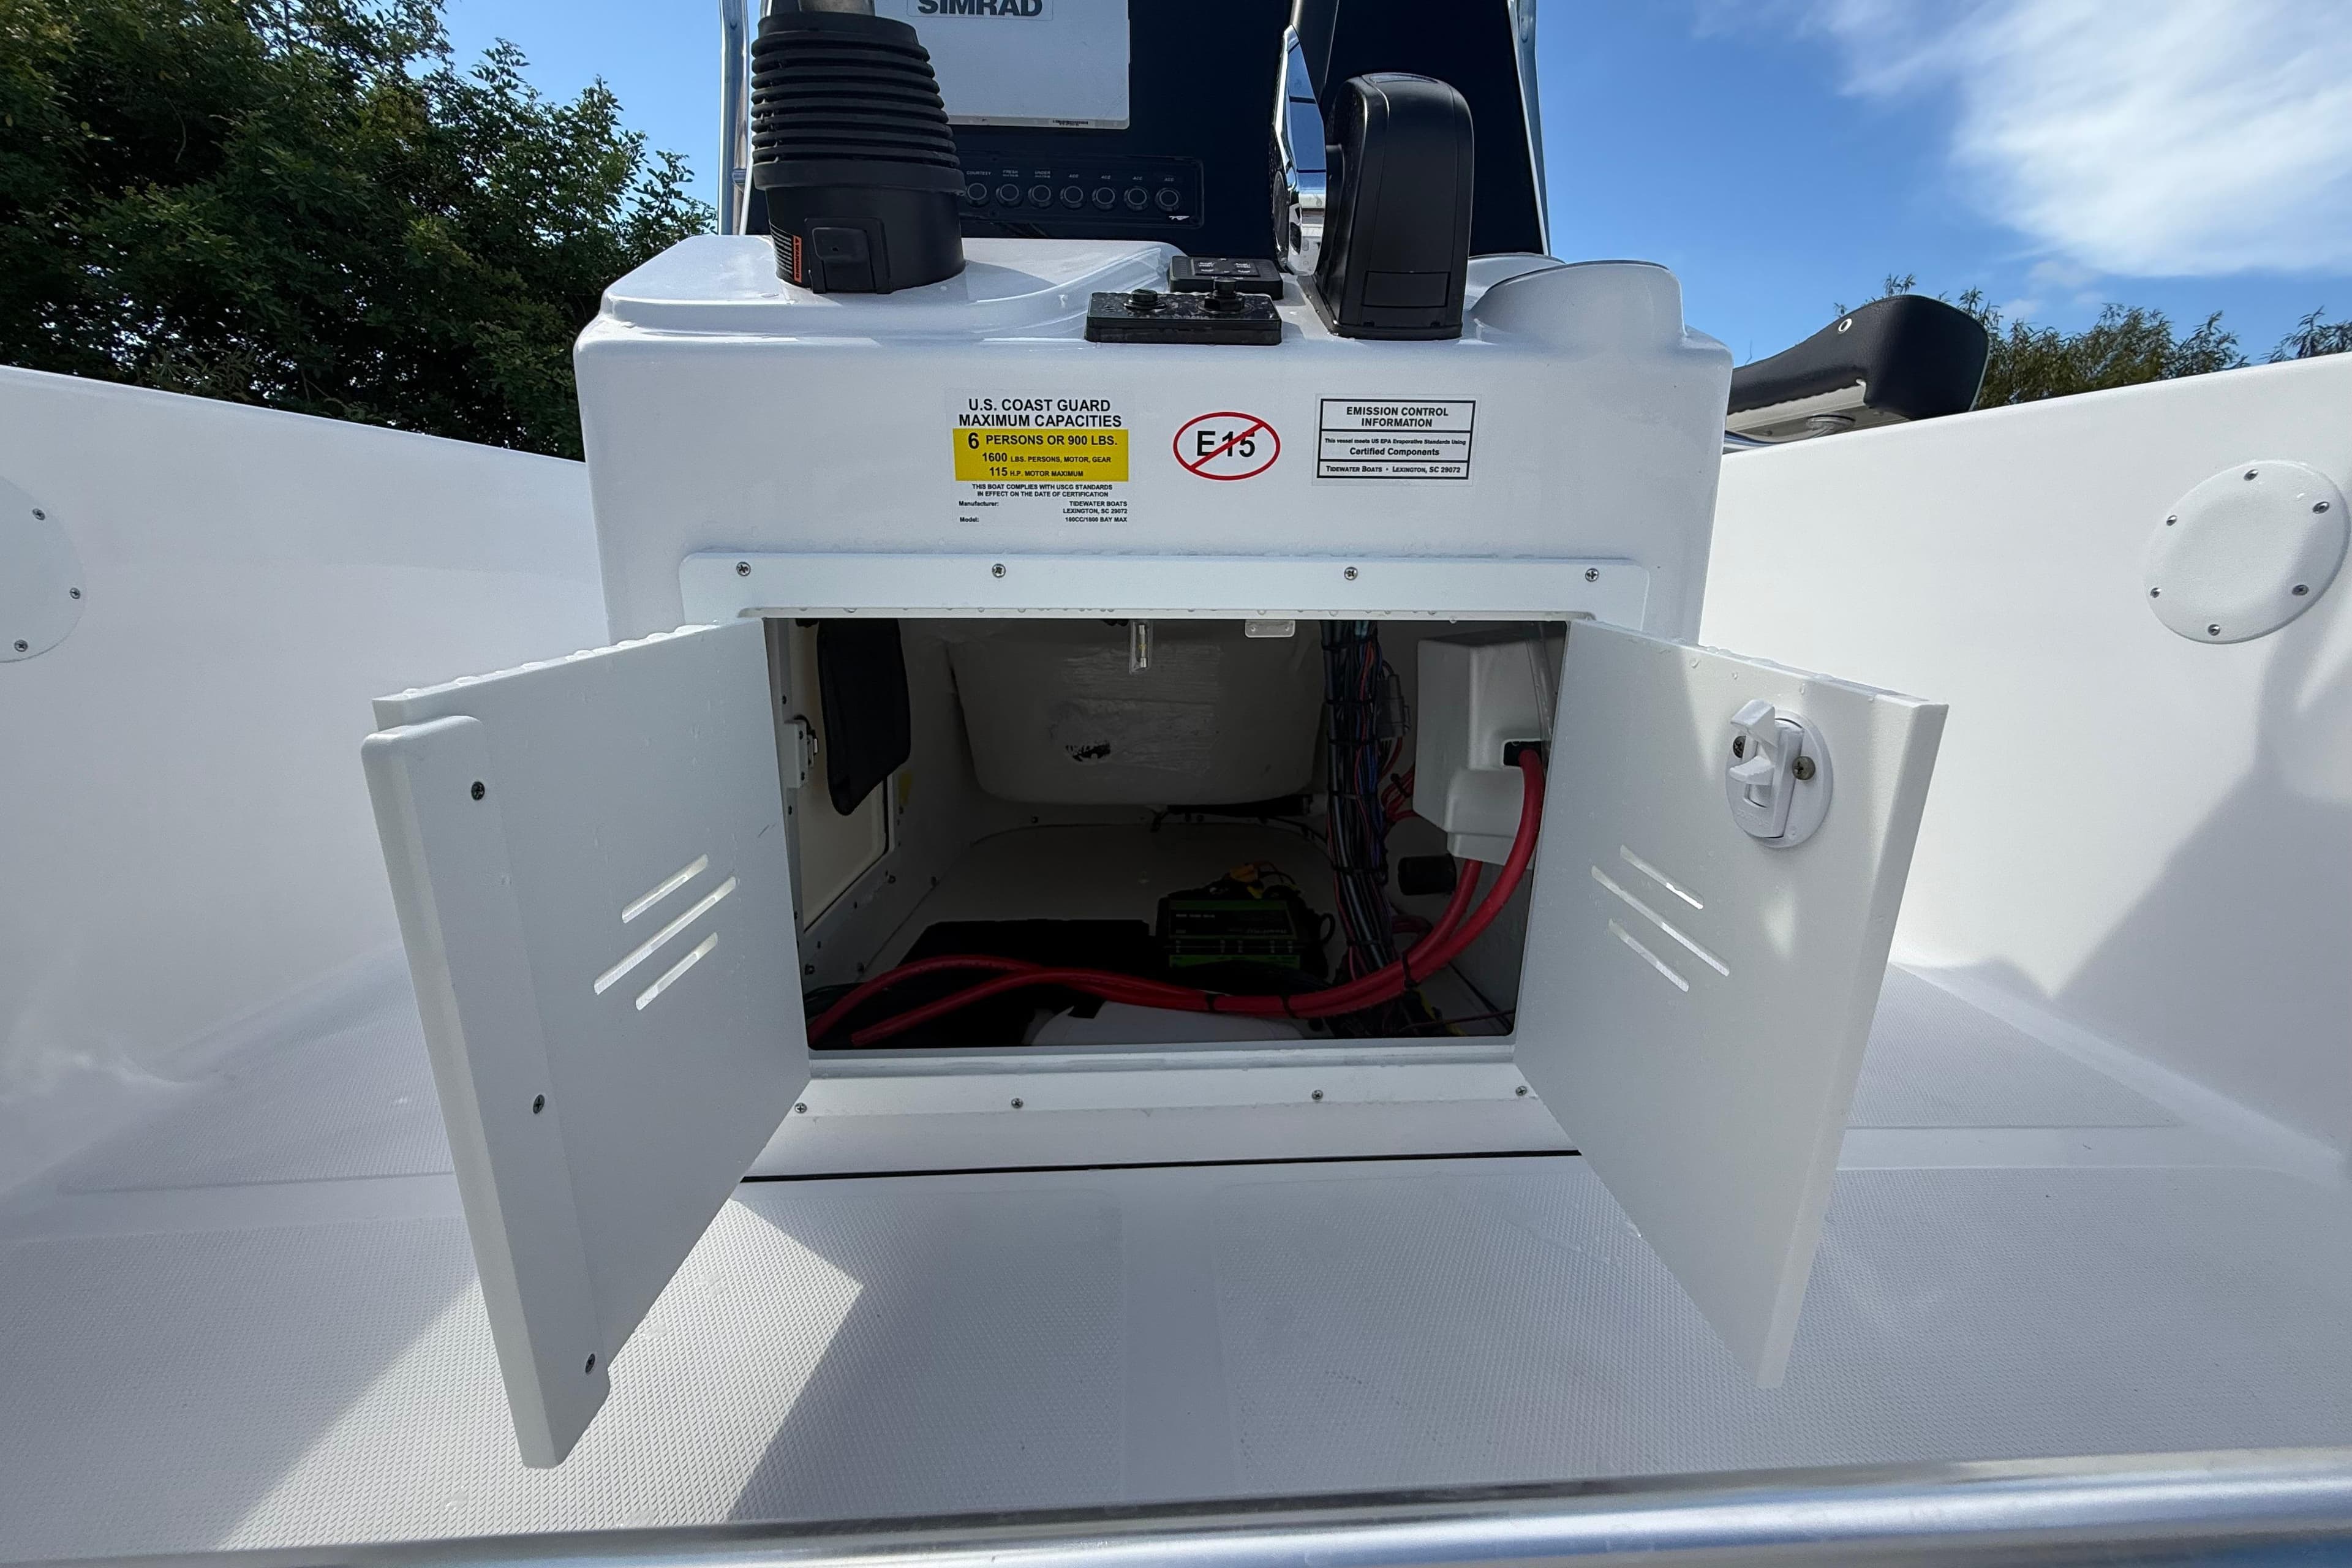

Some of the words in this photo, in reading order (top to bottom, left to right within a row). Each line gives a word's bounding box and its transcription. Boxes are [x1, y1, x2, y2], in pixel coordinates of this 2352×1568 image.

[918, 0, 1042, 17] SIMRAD
[968, 399, 997, 411] U.S.
[1001, 399, 1052, 412] COAST
[1057, 399, 1110, 412] GUARD
[1347, 407, 1398, 416] EMISSION
[1401, 407, 1449, 417] CONTROL
[959, 414, 1030, 427] MAXIMUM
[1035, 415, 1121, 428] CAPACITIES
[1362, 418, 1433, 427] INFORMATION
[968, 432, 979, 449] 6
[986, 435, 1044, 445] PERSONS
[1047, 435, 1065, 445] OR
[1068, 435, 1087, 445] 900
[1091, 435, 1118, 446] LBS.
[1197, 431, 1256, 458] E15
[982, 453, 1008, 462] 1600
[1387, 448, 1439, 456] Components
[989, 467, 1008, 477] 115
